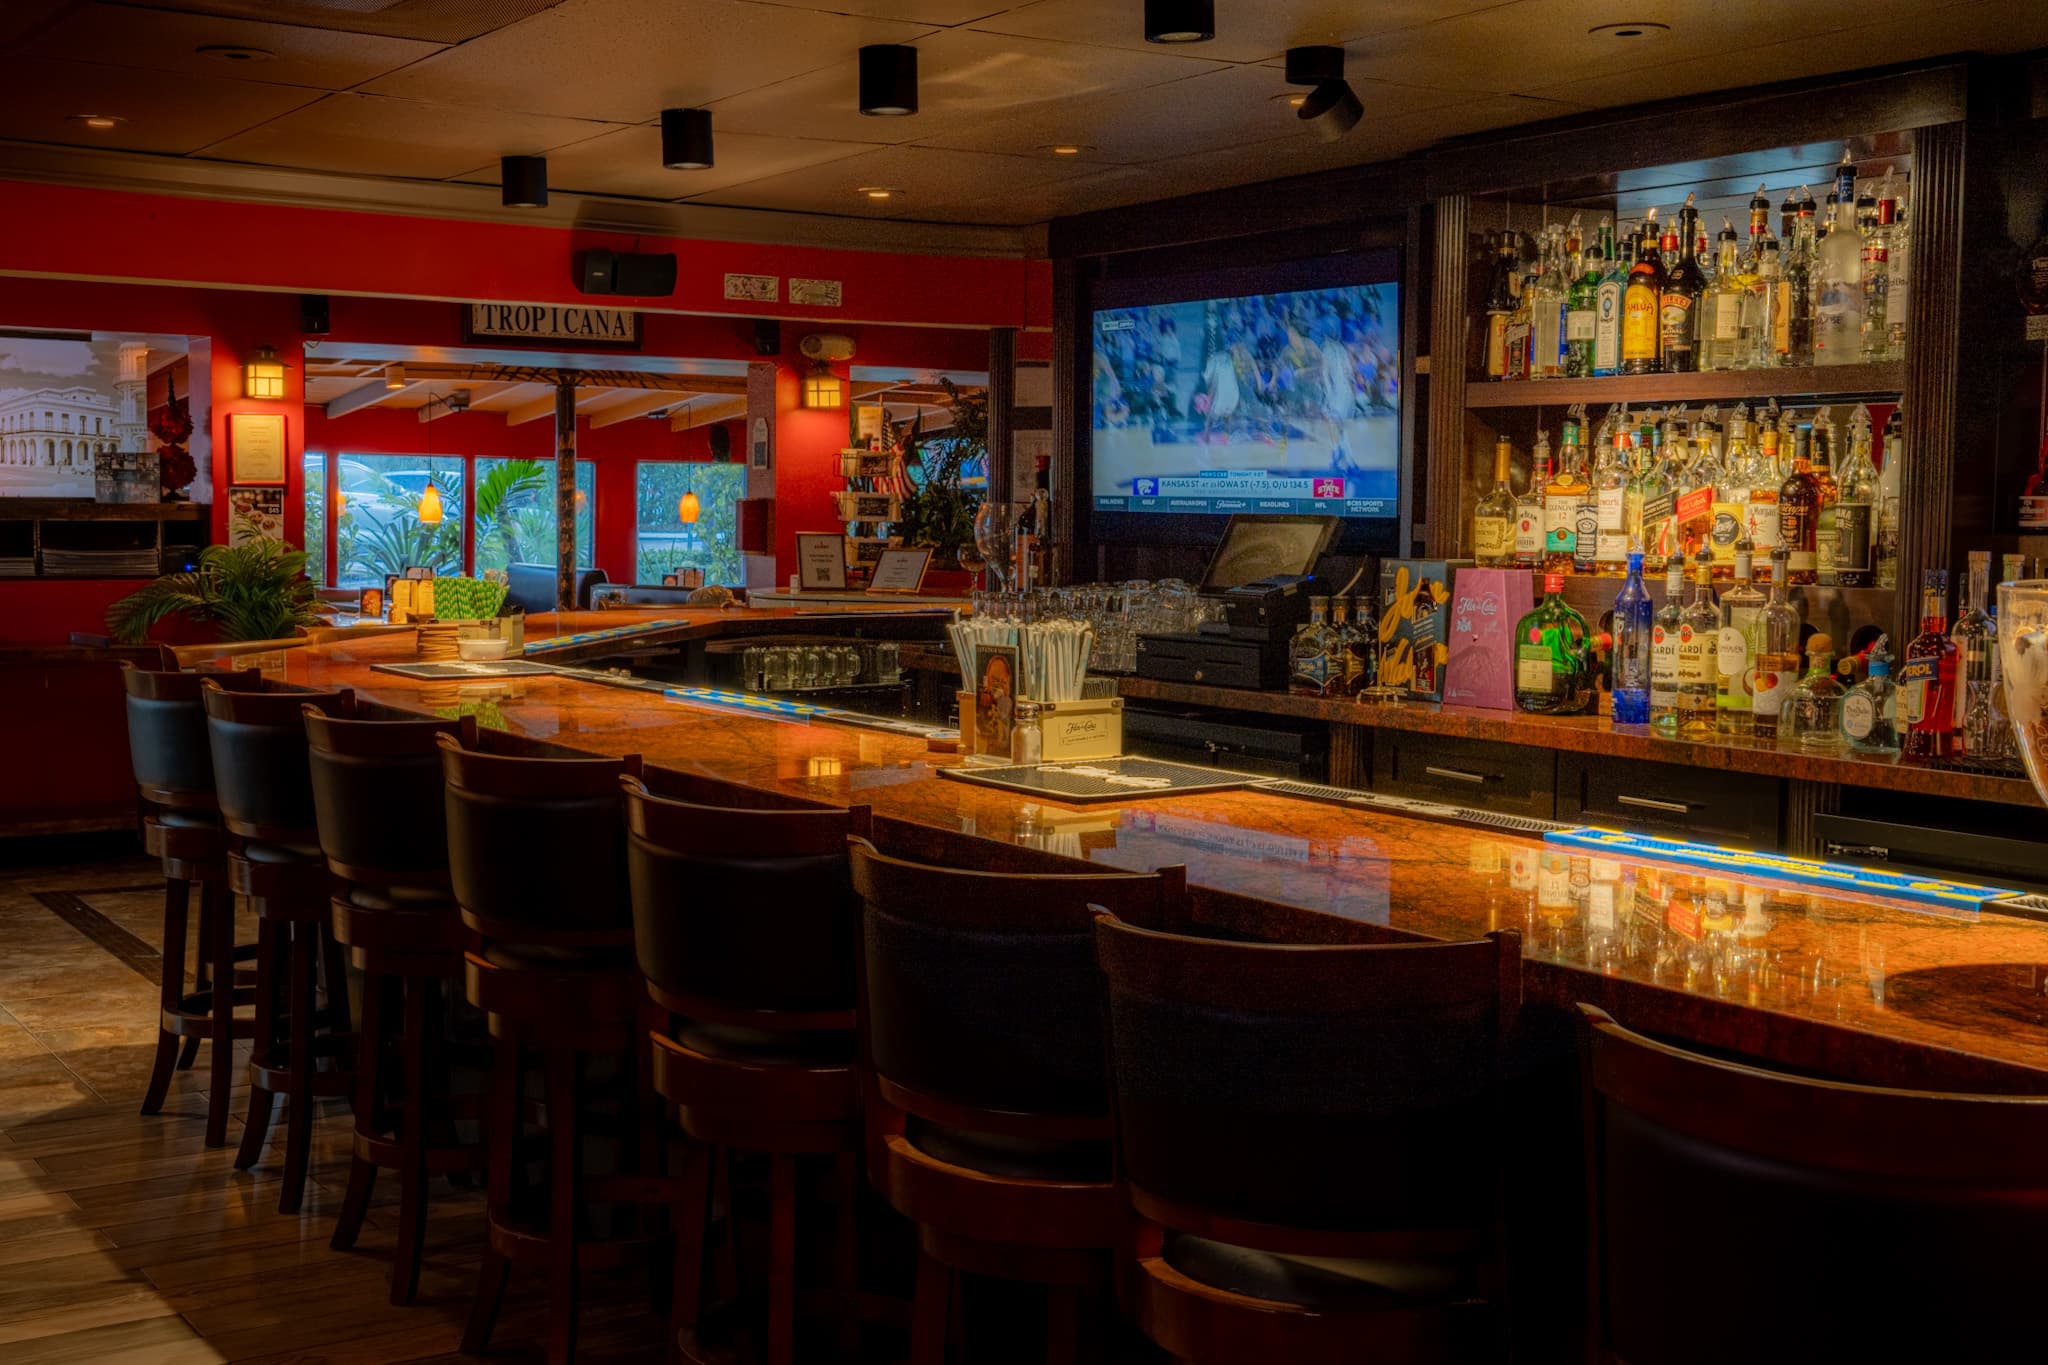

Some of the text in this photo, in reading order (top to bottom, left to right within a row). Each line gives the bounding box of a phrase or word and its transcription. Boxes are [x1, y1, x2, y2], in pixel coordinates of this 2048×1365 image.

[481, 303, 626, 336] TROPICANA
[1217, 481, 1238, 489] IOWA
[1273, 481, 1288, 489] O/U
